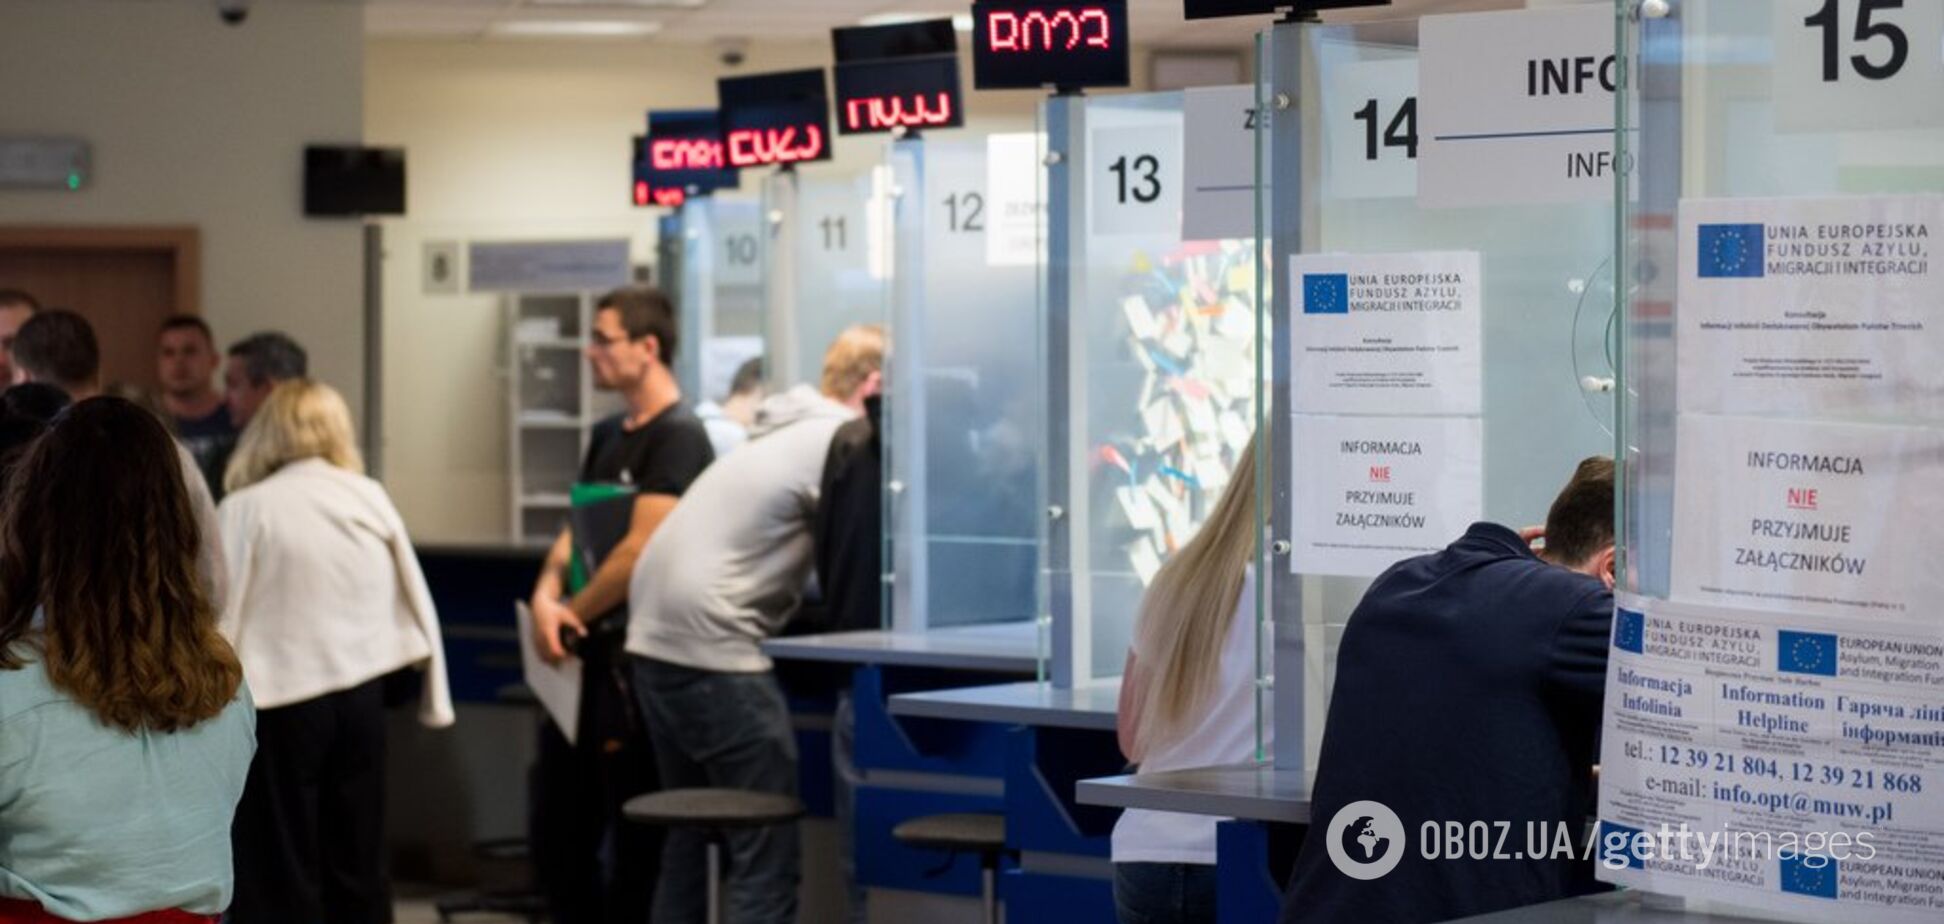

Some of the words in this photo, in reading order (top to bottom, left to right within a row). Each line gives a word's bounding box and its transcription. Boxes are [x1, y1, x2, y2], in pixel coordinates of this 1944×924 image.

[1804, 0, 1908, 82] 15
[1527, 54, 1640, 96] INFO
[1354, 97, 1419, 160] 14
[1108, 154, 1161, 204] 13
[943, 192, 985, 232] 12
[819, 216, 847, 250] 11
[1768, 224, 1809, 239] UNIA
[1818, 223, 1929, 239] EUROPEJSKA
[725, 233, 758, 265] 10
[1768, 243, 1850, 257] FUNDUSZ
[1862, 242, 1928, 259] AZYLU,
[1768, 261, 1833, 275] MIGRACJI
[1843, 261, 1928, 275] INTEGRACJI
[1350, 274, 1378, 286] UNIA
[1384, 273, 1461, 286] EUROPEJSKA
[1350, 287, 1407, 299] FUNDUSZ
[1415, 287, 1461, 300] AZYLU,
[1350, 300, 1396, 312] MIGRACJI
[1402, 300, 1461, 312] INTEGRACJI
[1340, 441, 1422, 455] INFORMACJA
[1369, 466, 1392, 480] NIE
[1748, 451, 1864, 475] INFORMACJA
[1346, 490, 1415, 506] PRZYJMUJE
[1787, 487, 1819, 509] NIE
[1336, 512, 1426, 530] ZAŁĄCZNIKÓW
[1751, 518, 1851, 543] PRZYJMUJE
[1735, 548, 1866, 576] ZAŁĄCZNIKÓW
[1679, 621, 1761, 640] EUROPEJSKA
[1711, 639, 1760, 655] AZYLU,
[1840, 636, 1902, 653] EUROPEAN
[1904, 643, 1943, 657] UNION
[1699, 651, 1760, 667] INTEGRACJI
[1839, 652, 1882, 667] Asylum,
[1885, 655, 1940, 671] Migration
[1617, 666, 1693, 698] Informacja
[1839, 667, 1860, 678] and
[1861, 668, 1923, 683] Integration
[1623, 692, 1682, 718] Infolinia
[1722, 683, 1825, 710] Information
[1837, 696, 1904, 719] Гаряча
[1738, 709, 1809, 733] Helpline
[1624, 740, 1653, 761] tel.:
[1661, 745, 1680, 765] 12
[1686, 748, 1708, 768] 39
[1715, 752, 1735, 773] 21
[1742, 756, 1784, 781] 804,
[1792, 762, 1813, 783] 12
[1820, 765, 1844, 786] 39
[1851, 768, 1874, 789] 21
[1883, 772, 1922, 793] 868
[1645, 775, 1706, 798] e-mail:
[1713, 780, 1892, 824] info.opt@muw.pl
[1704, 867, 1765, 886] INTEGRACJI
[1840, 861, 1904, 876] EUROPEAN
[1906, 867, 1944, 881] UNION
[1840, 875, 1885, 891] Asylum,
[1886, 879, 1943, 894] Migration
[1840, 890, 1862, 901] and
[1863, 891, 1926, 906] Integration
